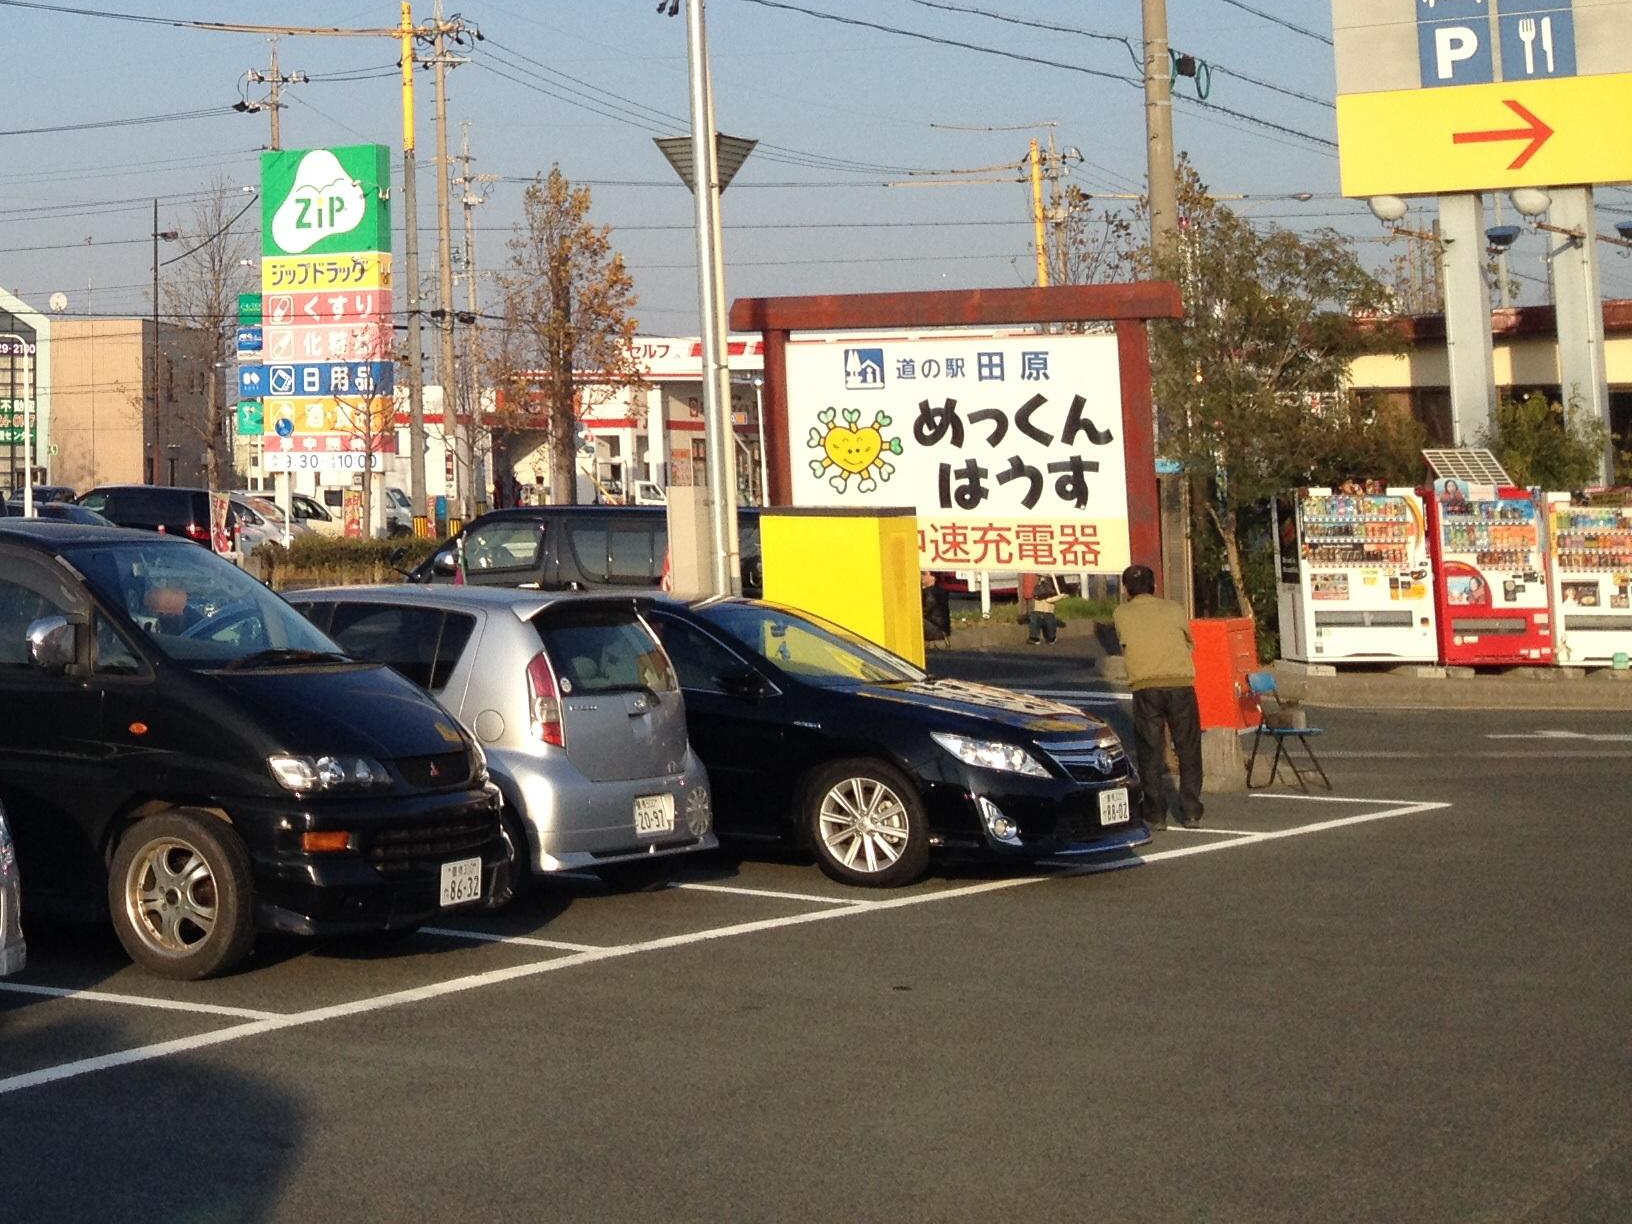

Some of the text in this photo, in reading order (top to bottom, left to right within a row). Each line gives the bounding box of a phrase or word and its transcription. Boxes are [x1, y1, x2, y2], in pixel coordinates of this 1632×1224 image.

[1434, 26, 1478, 79] P
[272, 260, 368, 286] ジップドラッグ
[304, 294, 373, 321] くすり
[629, 344, 670, 359] セルフ
[303, 366, 374, 392] 日用品
[895, 351, 1050, 381] 道の駅 田原
[913, 393, 1114, 448] めっくん
[938, 455, 1100, 511] はうす
[918, 523, 1101, 567] 速充電器
[638, 809, 665, 830] 20-97
[449, 876, 479, 900] 86-32
